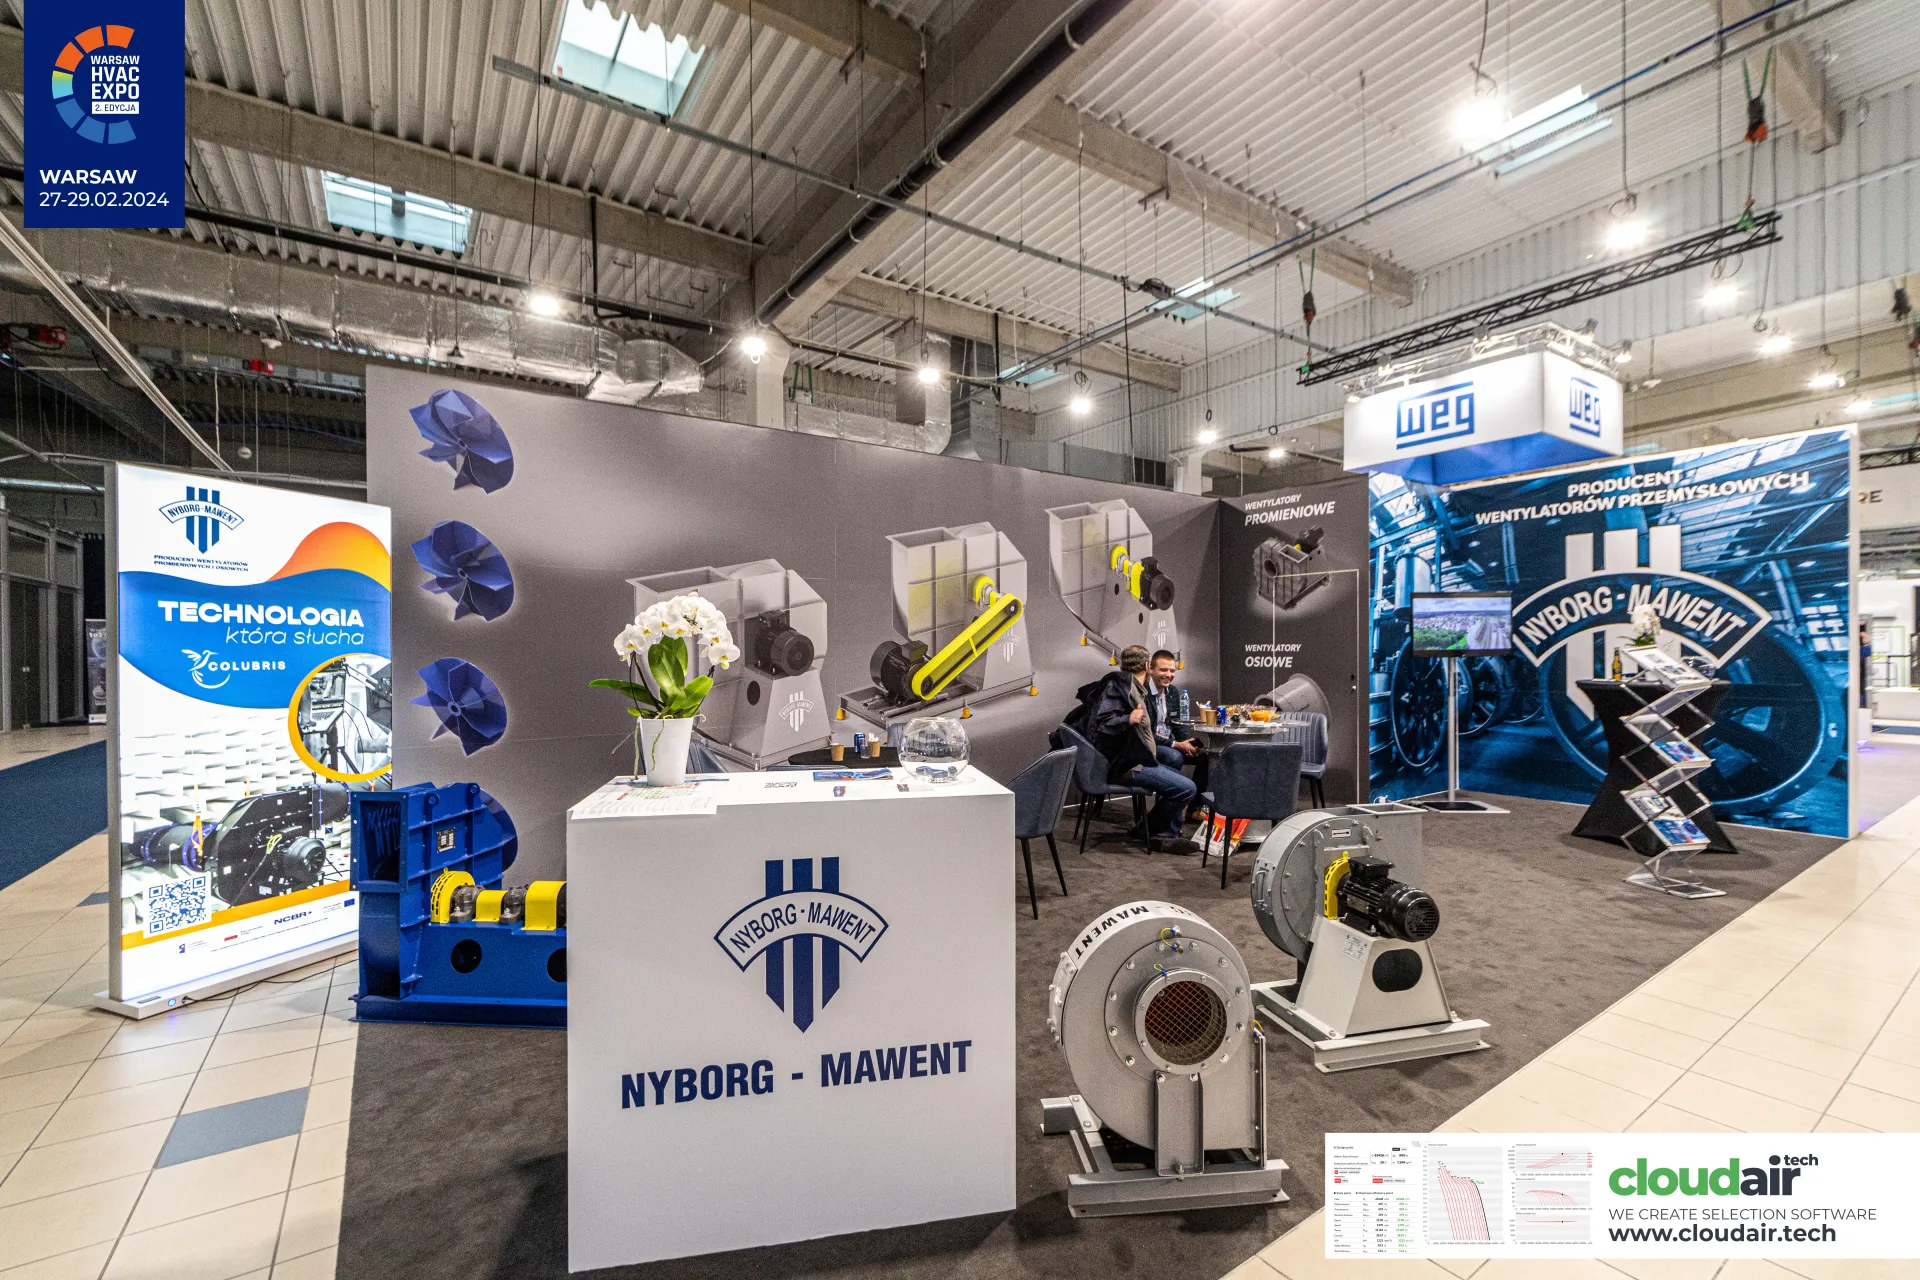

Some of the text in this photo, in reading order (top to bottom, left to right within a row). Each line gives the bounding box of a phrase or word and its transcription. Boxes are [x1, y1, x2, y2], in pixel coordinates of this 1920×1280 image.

[1567, 469, 1683, 498] PRODUCENT
[1244, 493, 1302, 511] WENTYLATORY
[1475, 470, 1811, 525] WENTYLATORÓW PRZEMYSŁOWYCH
[1244, 500, 1336, 527] PROMIENIOWE
[153, 554, 195, 563] PRODUCENT
[157, 600, 365, 628] TECHNOLOGIA
[225, 626, 365, 645] która słucha
[1244, 643, 1302, 652] WENTYLATORY
[208, 660, 286, 672] COLUBRIS
[1244, 655, 1294, 668] OSIOWE
[1074, 905, 1150, 960] MAWENT
[621, 1059, 775, 1110] NYBORG
[820, 1039, 972, 1088] MAWENT
